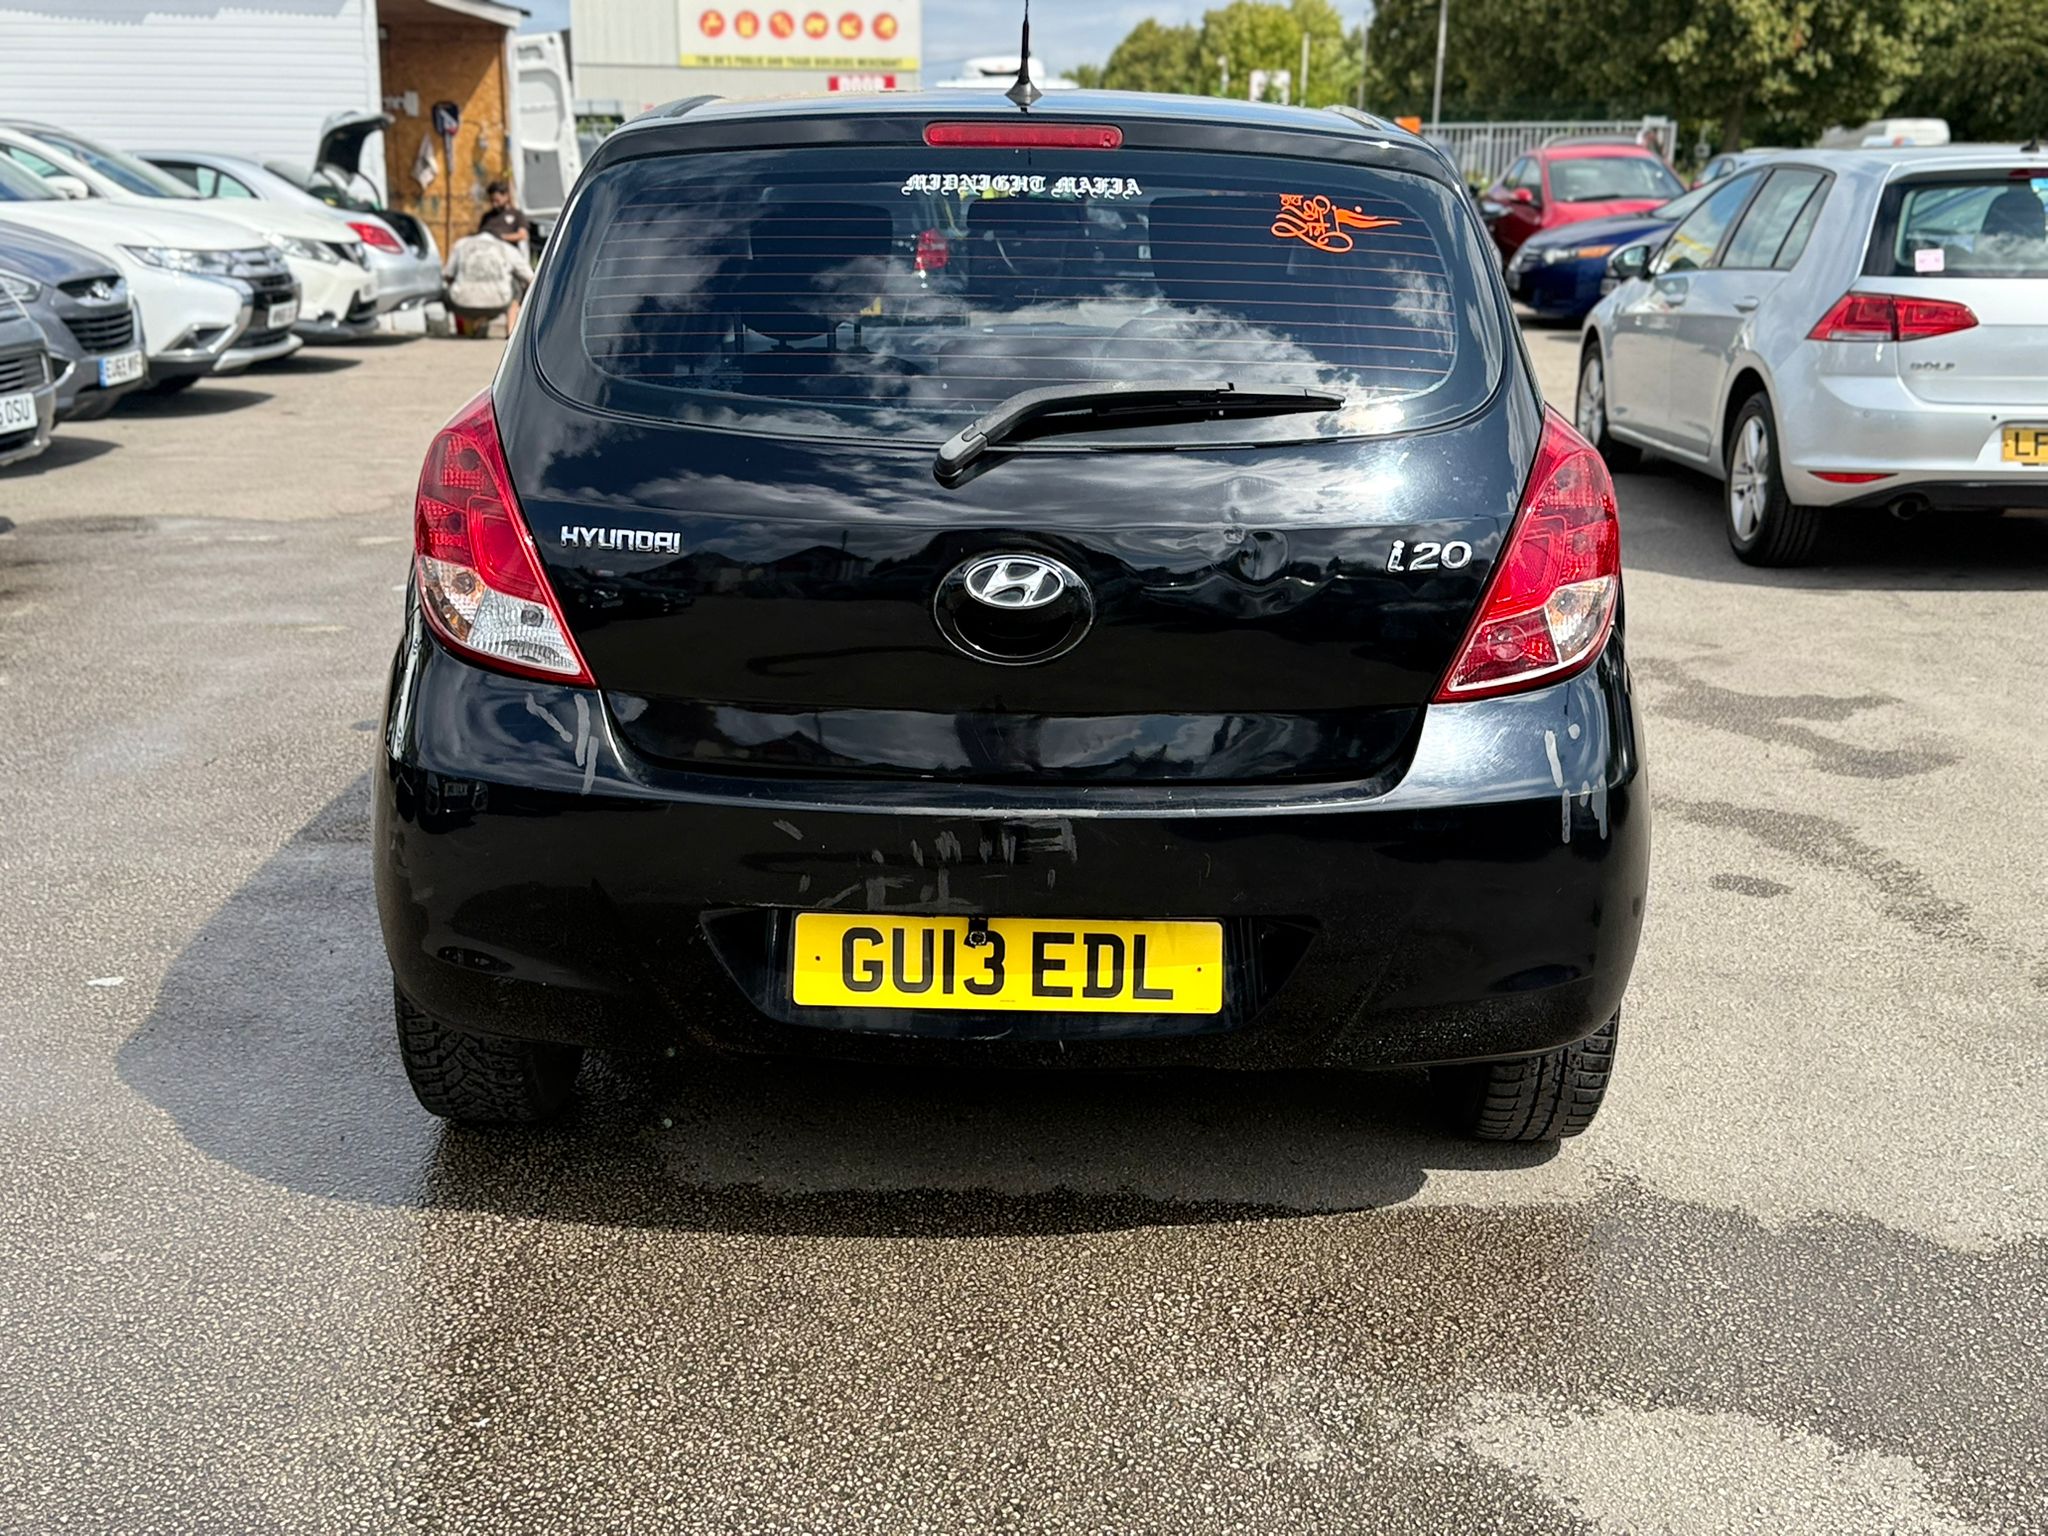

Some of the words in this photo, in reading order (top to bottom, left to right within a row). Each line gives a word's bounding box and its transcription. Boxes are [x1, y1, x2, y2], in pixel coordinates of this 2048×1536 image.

[901, 173, 1046, 197] MIDNIGHT
[1051, 176, 1142, 199] MAFIA
[561, 525, 681, 554] HYUNDAI
[1387, 539, 1473, 573] i20
[842, 927, 1006, 996] GU13
[1032, 931, 1174, 1000] EDL
